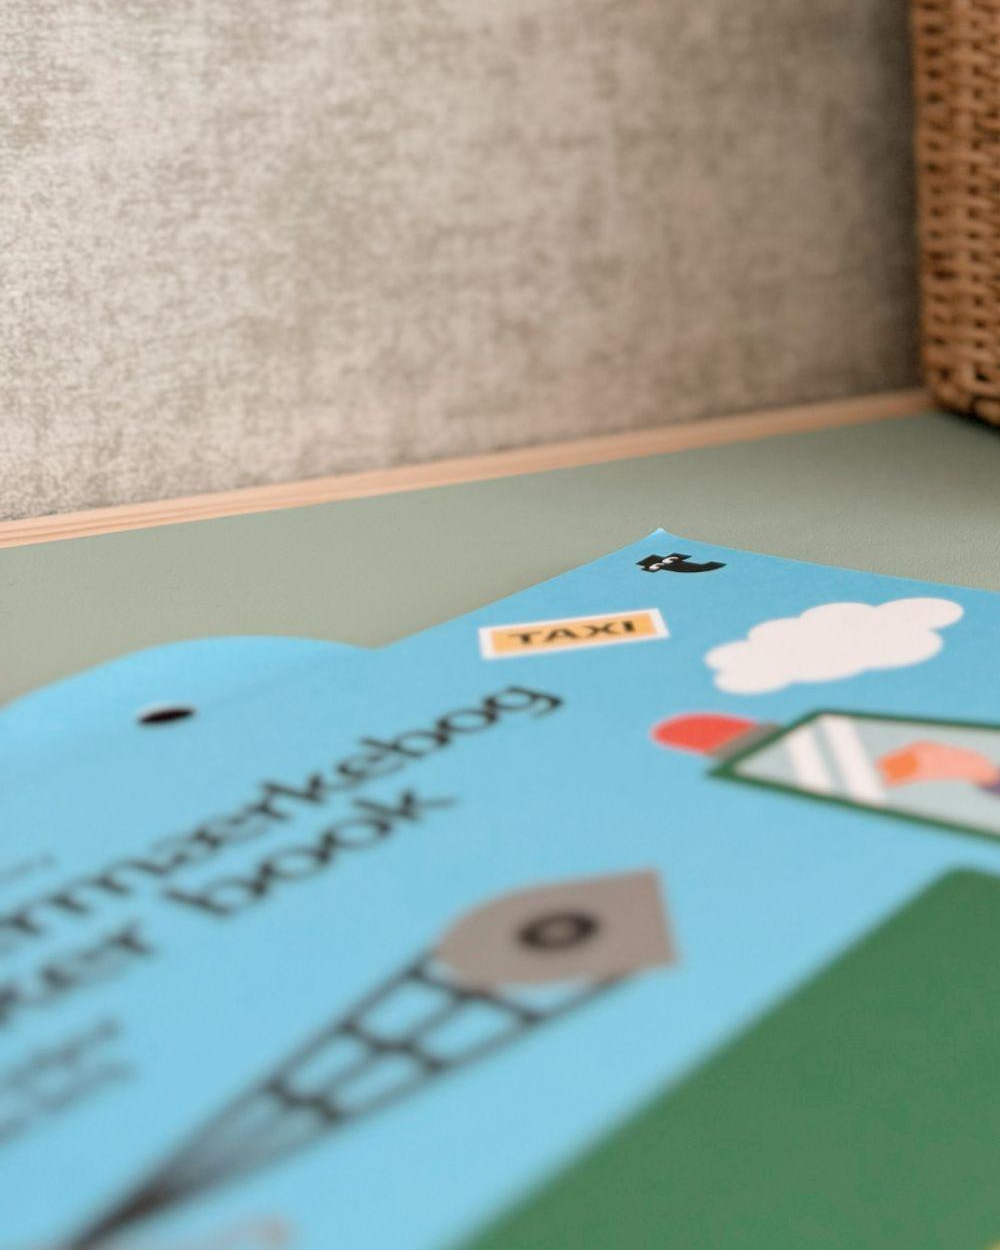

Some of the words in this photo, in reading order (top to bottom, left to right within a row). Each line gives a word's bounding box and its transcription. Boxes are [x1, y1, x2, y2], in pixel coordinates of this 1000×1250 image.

[508, 620, 637, 646] TAXI
[0, 685, 563, 948] rmærkebog
[160, 786, 458, 918] book
